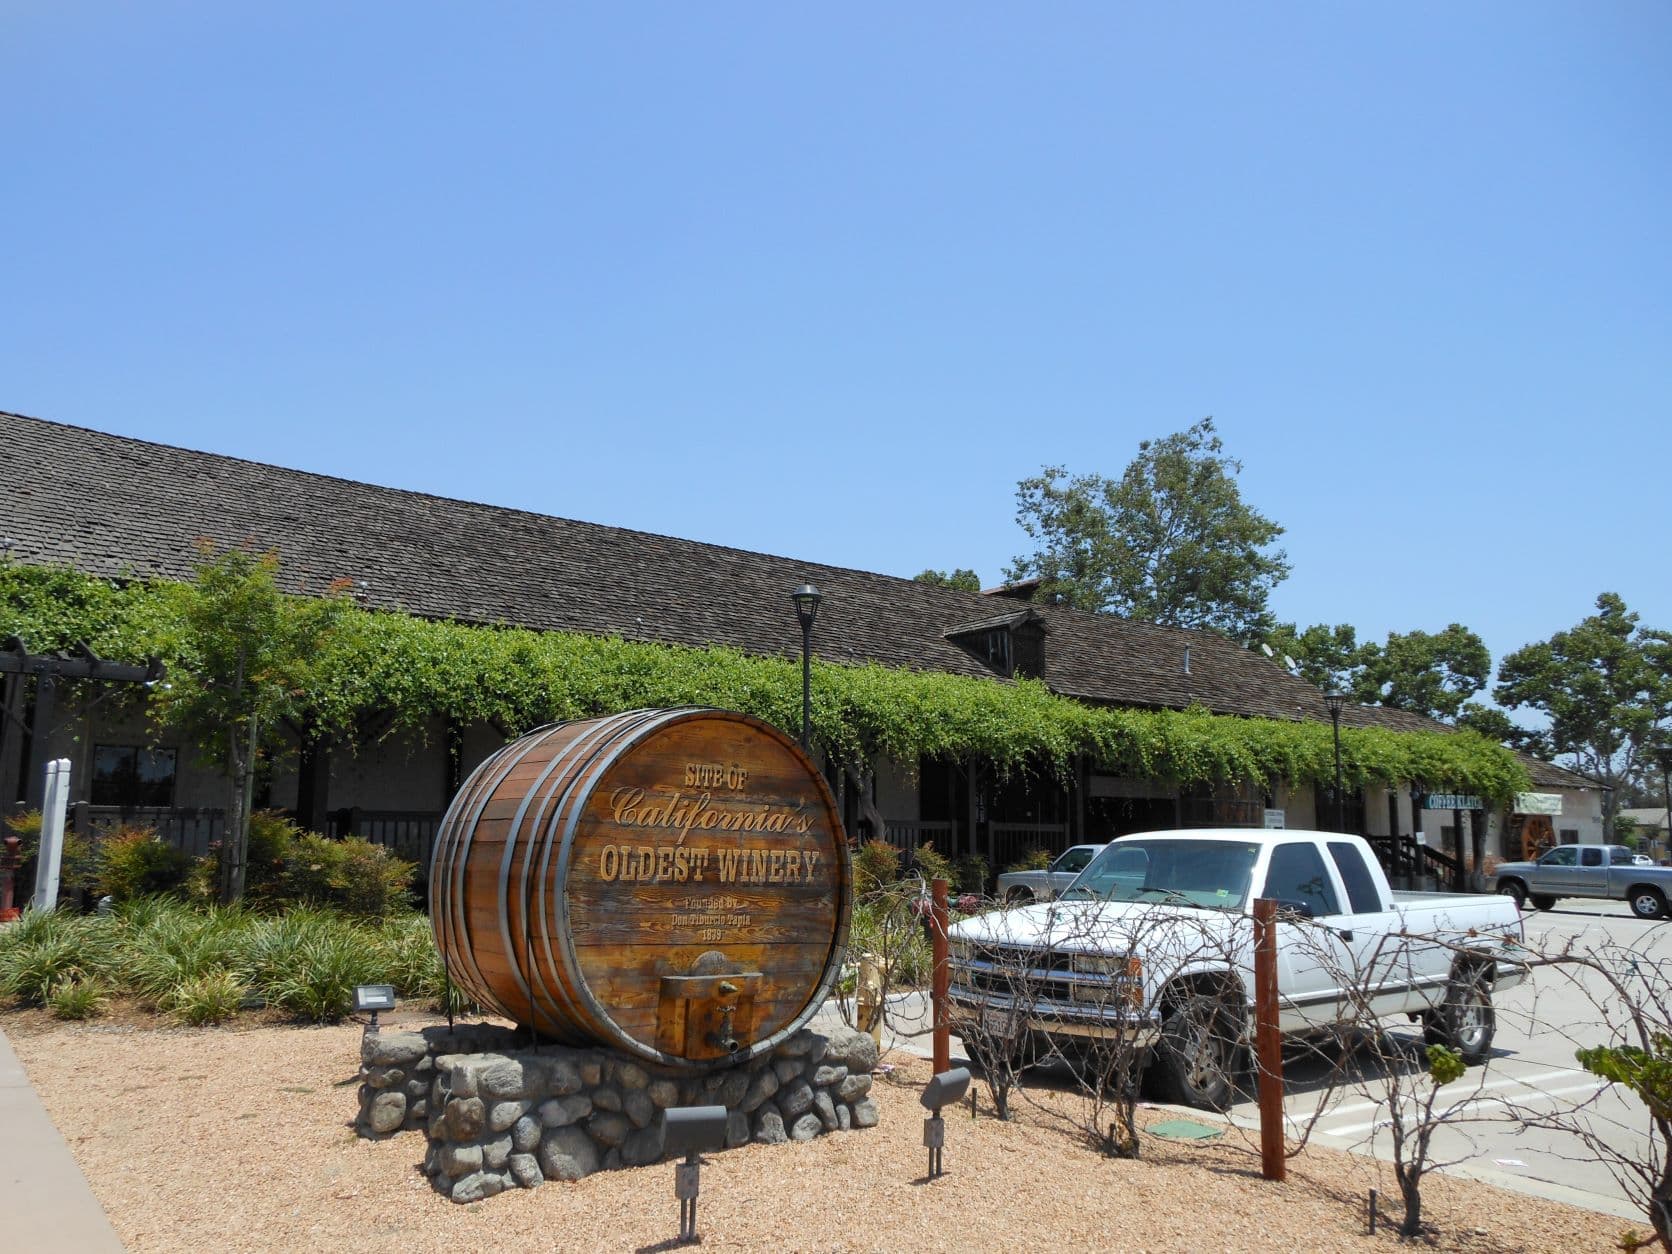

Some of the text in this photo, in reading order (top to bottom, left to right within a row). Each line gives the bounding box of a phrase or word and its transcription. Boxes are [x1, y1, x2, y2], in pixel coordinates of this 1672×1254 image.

[685, 763, 749, 790] SITE OF
[610, 786, 816, 844] California's
[600, 844, 820, 883] OLDEST WINERY
[671, 914, 751, 927] Don Tiburcio Tapia
[702, 928, 722, 940] 1839
